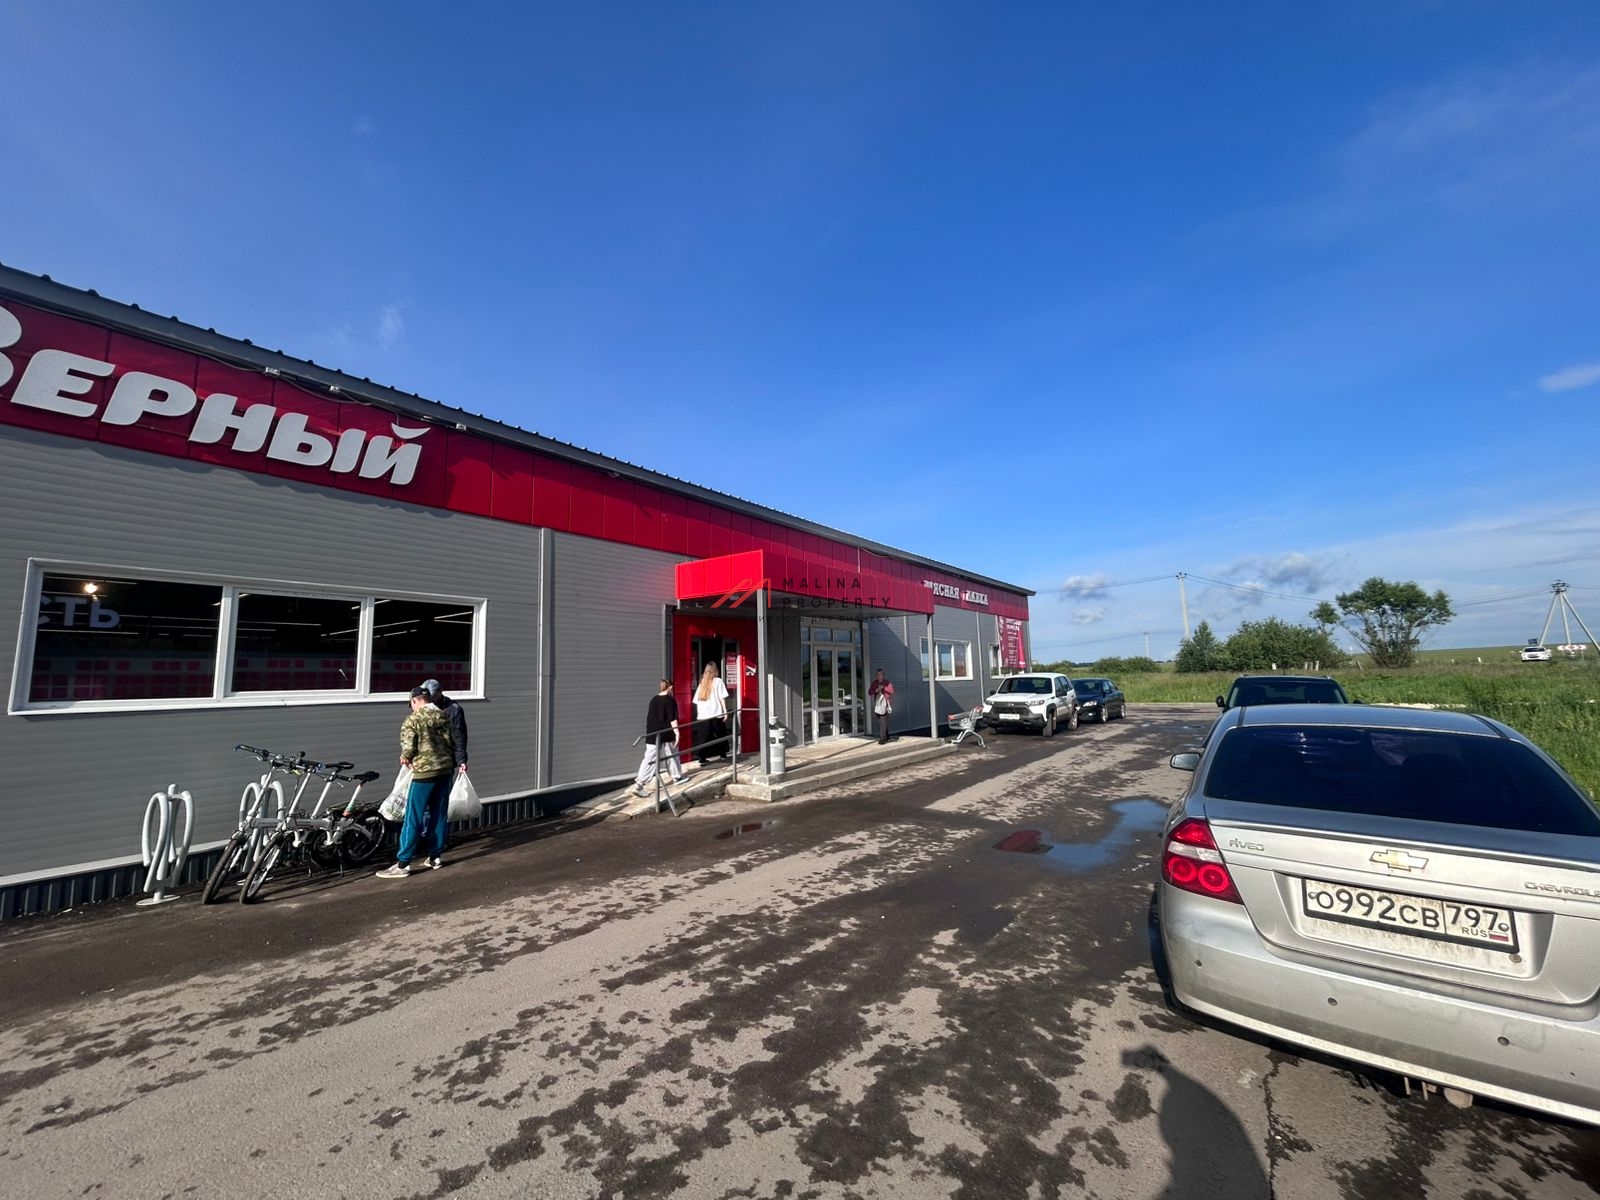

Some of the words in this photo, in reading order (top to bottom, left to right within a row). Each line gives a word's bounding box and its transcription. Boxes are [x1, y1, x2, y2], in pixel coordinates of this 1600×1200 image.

[1316, 888, 1441, 929] О992СВ
[1446, 904, 1500, 931] 797
[1462, 926, 1489, 939] RUS
